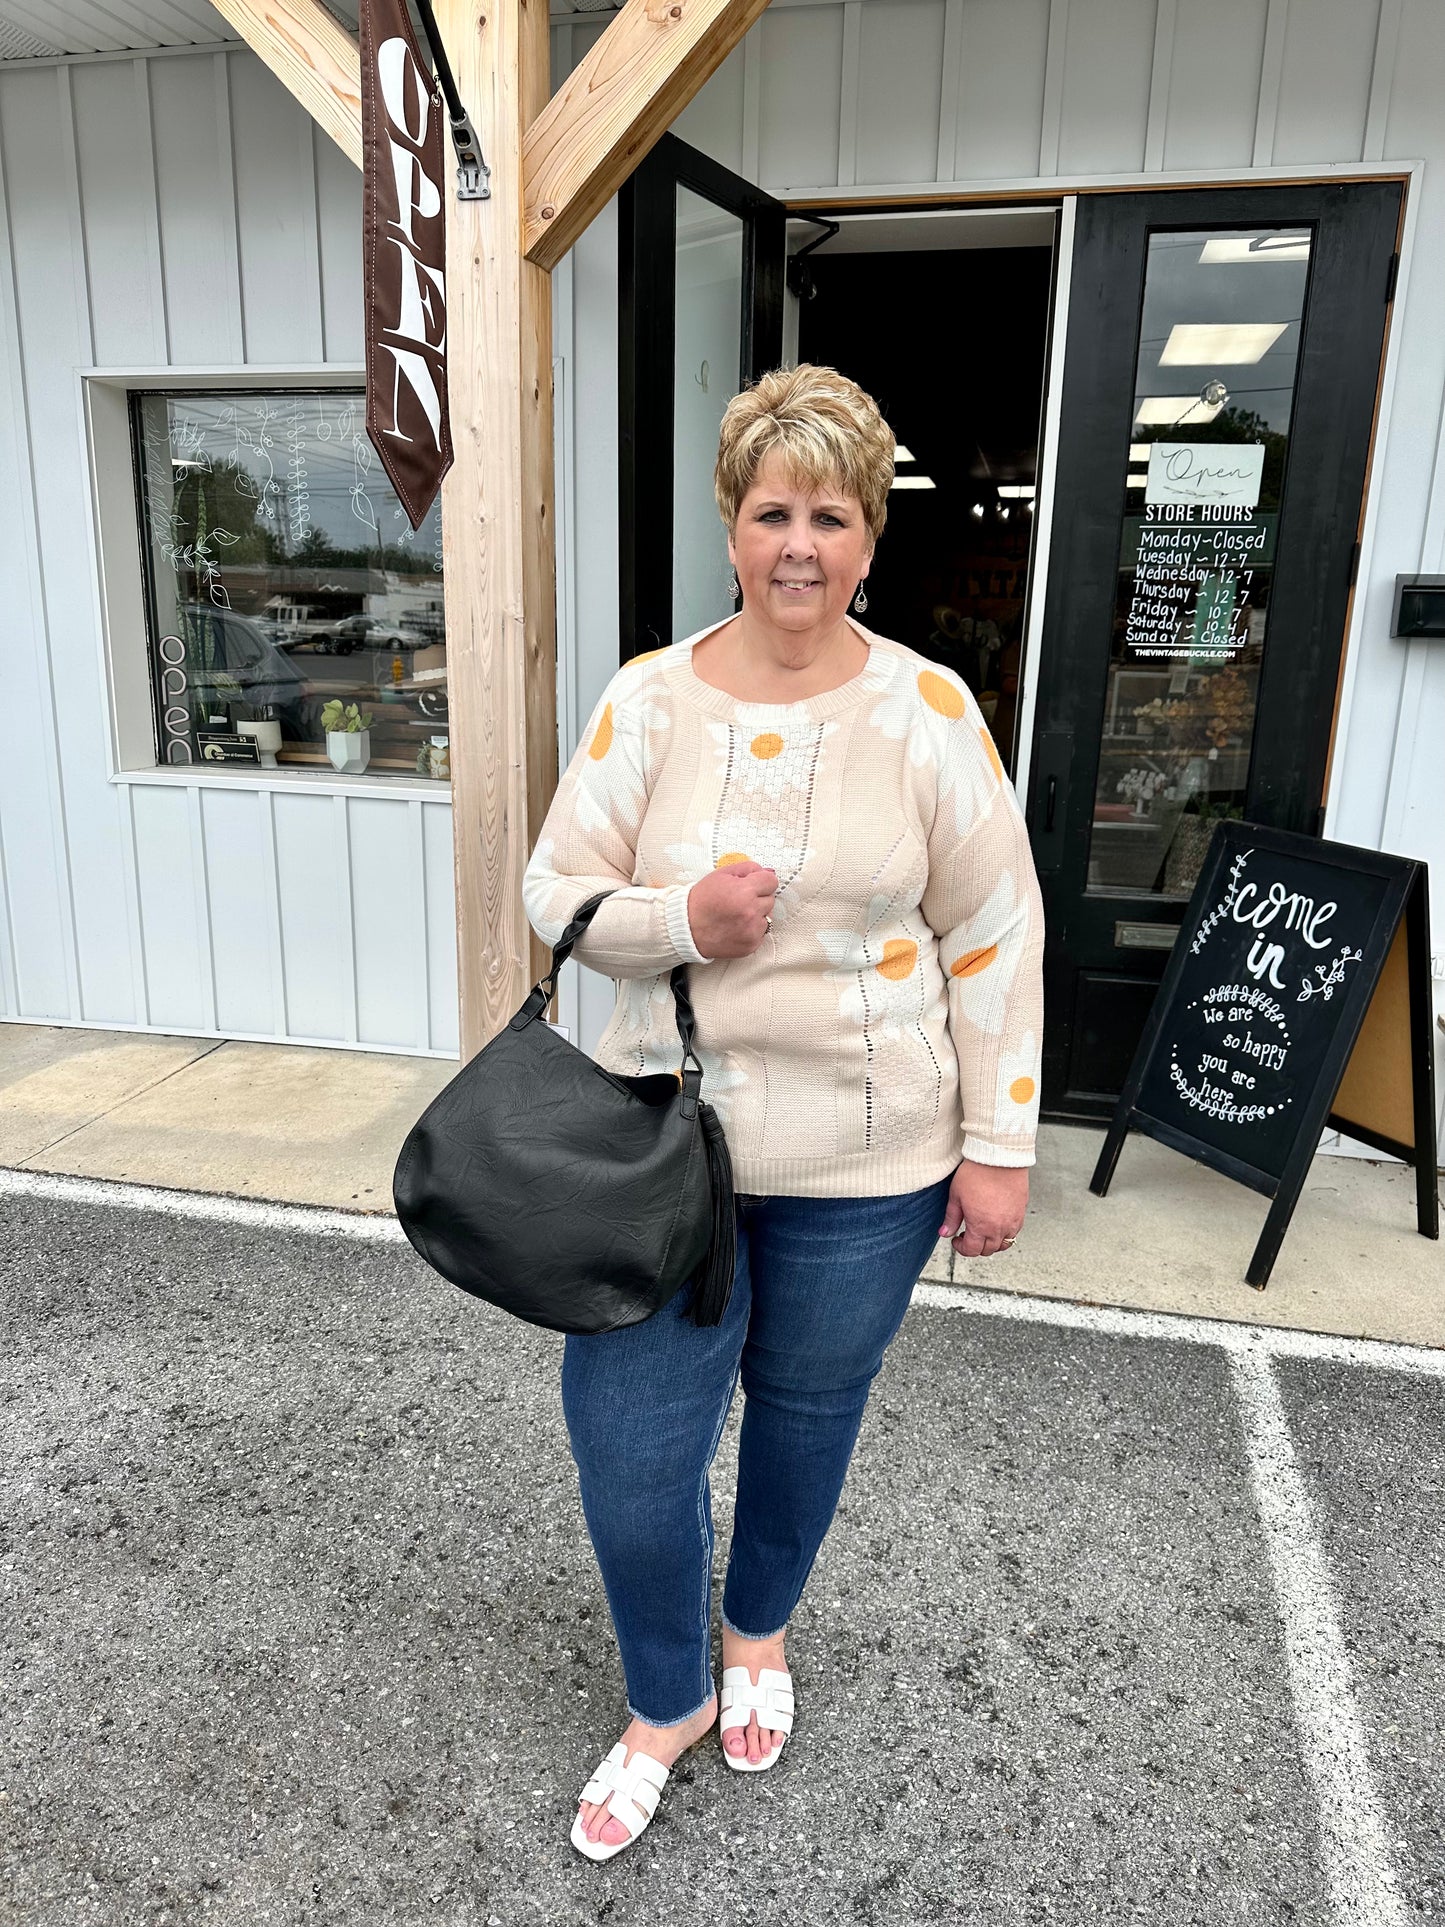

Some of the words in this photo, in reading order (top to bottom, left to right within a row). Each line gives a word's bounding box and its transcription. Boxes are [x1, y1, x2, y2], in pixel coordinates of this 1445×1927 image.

[378, 37, 446, 453] OPEN
[1161, 448, 1254, 488] Open
[1145, 504, 1195, 522] STORE
[1201, 504, 1254, 522] HOURS
[1136, 548, 1192, 569] Tuesday
[1133, 580, 1191, 603] Thursday
[1131, 597, 1178, 622] Friday
[1127, 612, 1182, 633] Saturday
[1126, 626, 1177, 645] Sunday
[1200, 628, 1248, 645] Closed
[1134, 649, 1236, 658] THEVINTAGEBUCKLE.COM
[159, 635, 193, 764] open
[1246, 932, 1287, 989] in
[1203, 1008, 1225, 1024] We
[1228, 1007, 1254, 1022] are
[1222, 1033, 1241, 1049] so
[1241, 1031, 1288, 1071] happy
[1198, 1054, 1228, 1073] you
[1231, 1070, 1256, 1090] are
[1200, 1076, 1234, 1106] here
